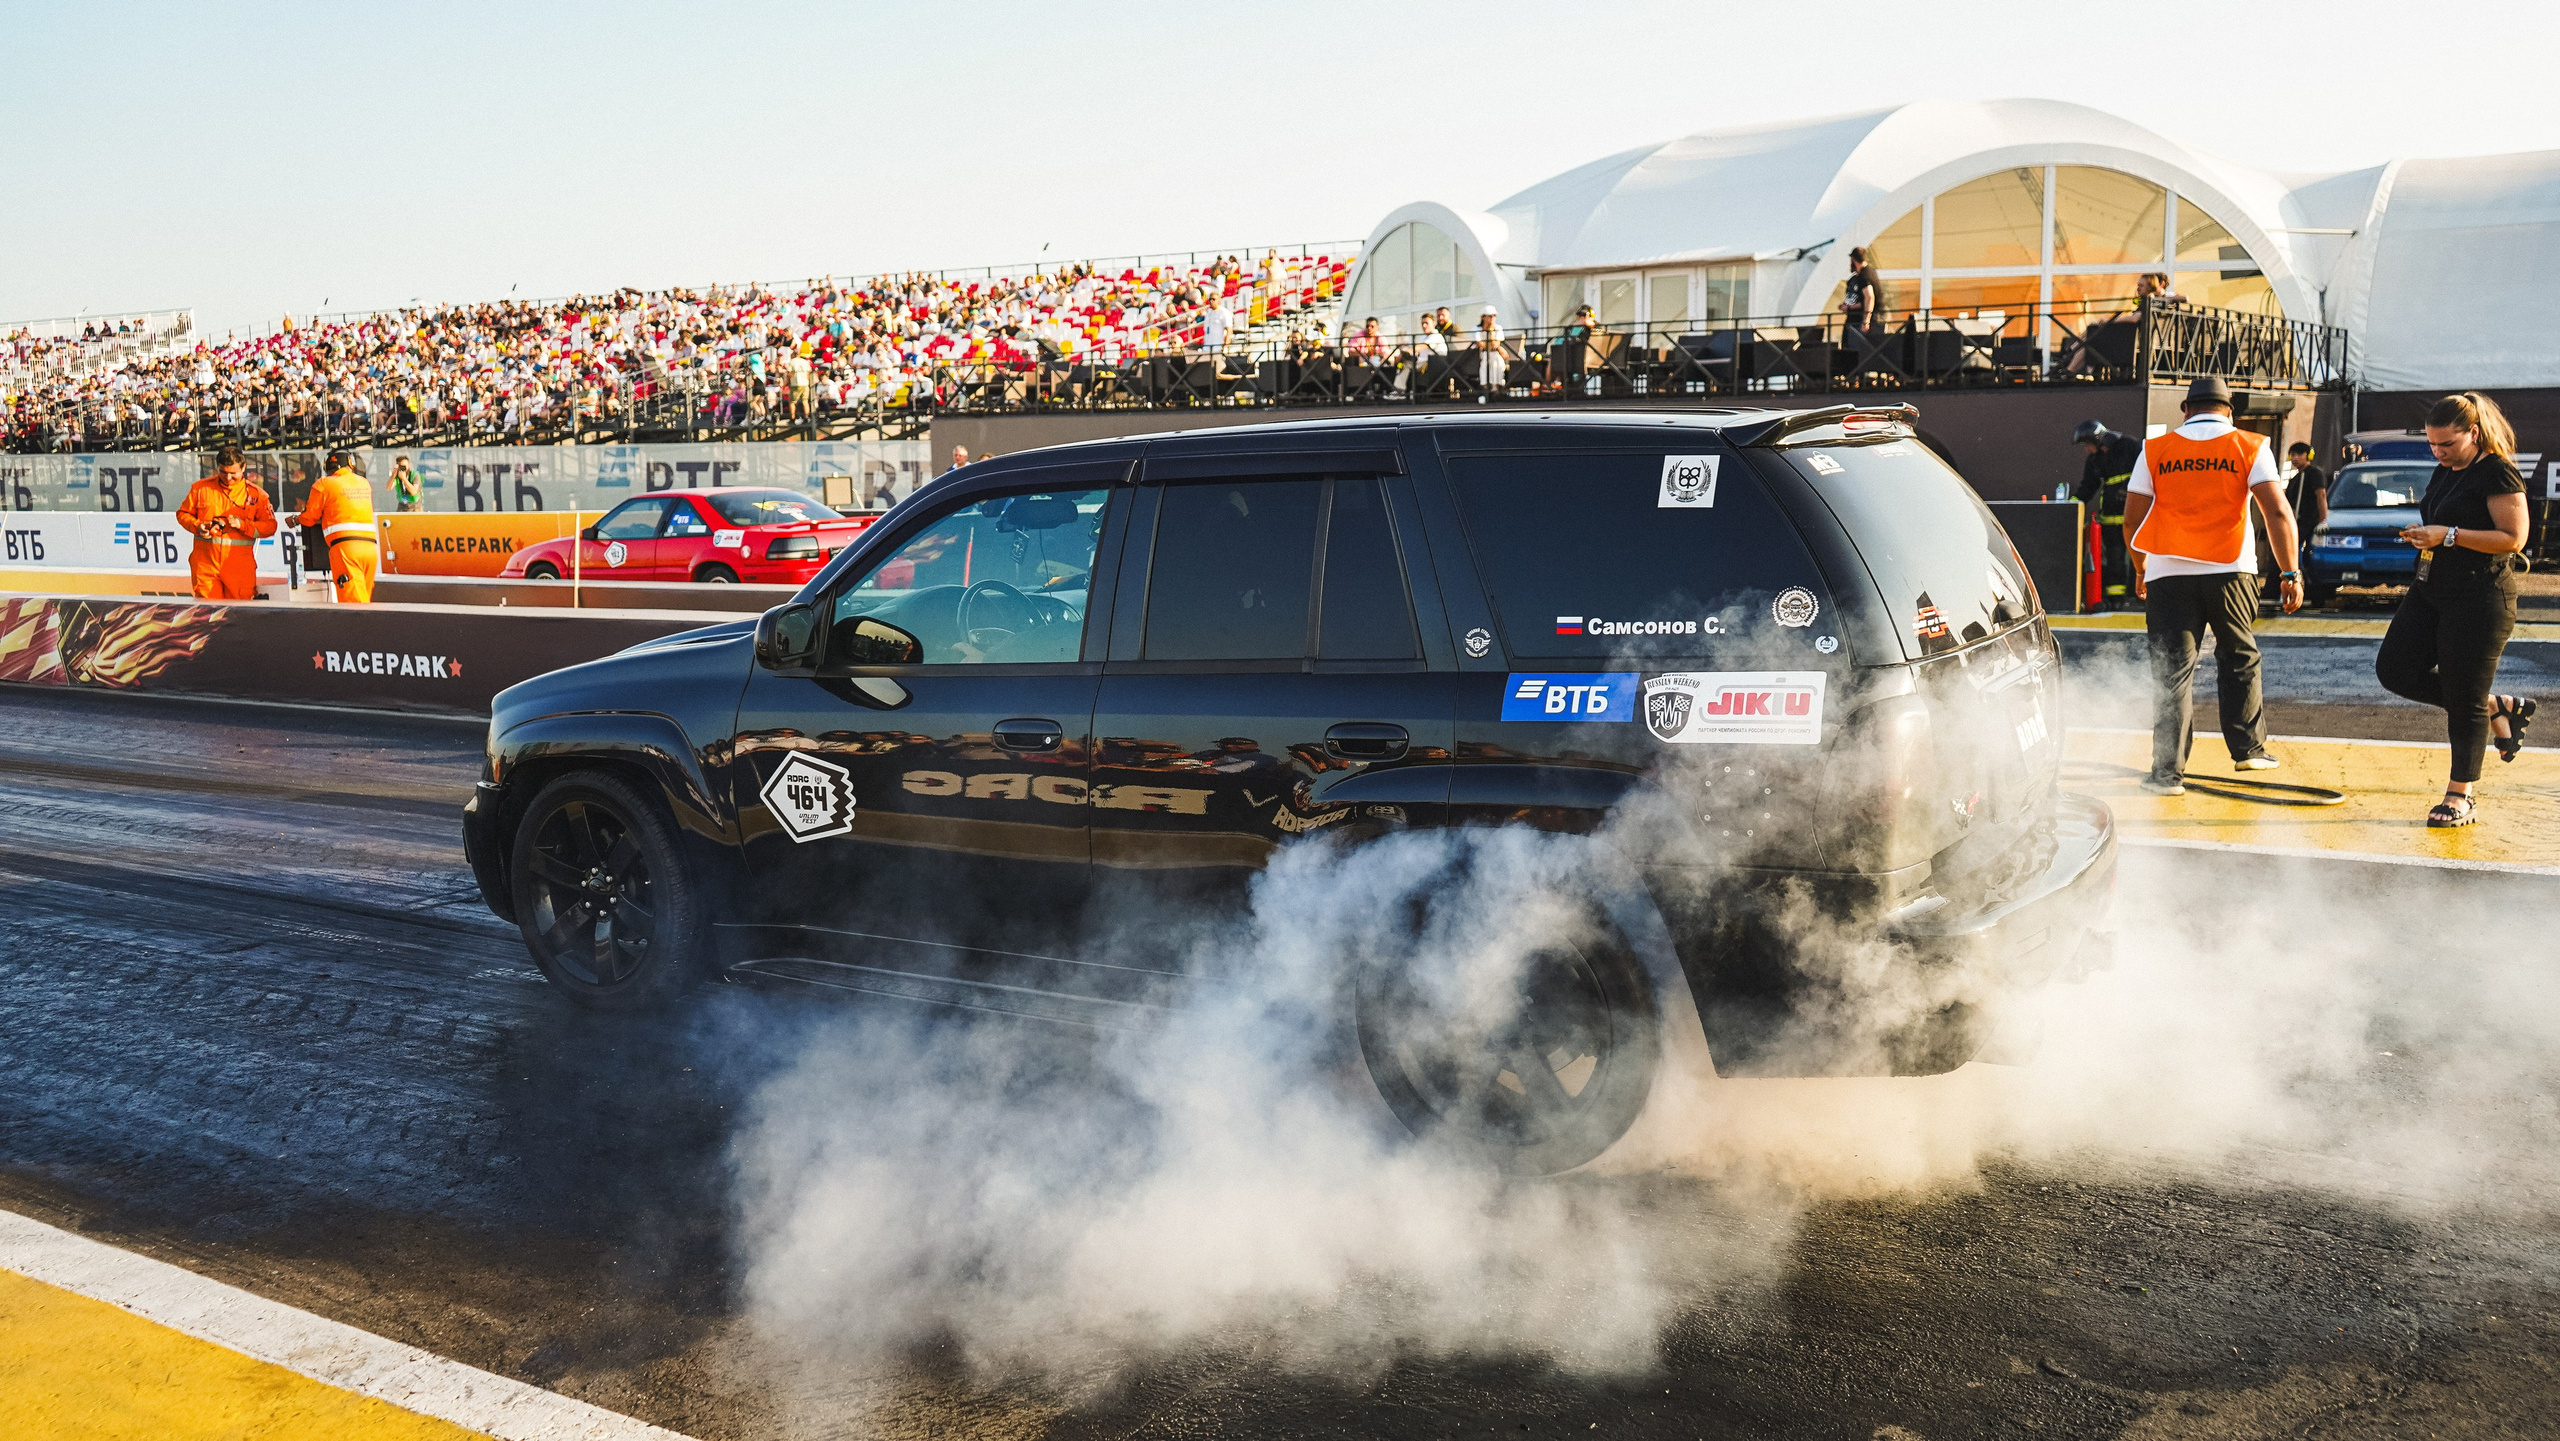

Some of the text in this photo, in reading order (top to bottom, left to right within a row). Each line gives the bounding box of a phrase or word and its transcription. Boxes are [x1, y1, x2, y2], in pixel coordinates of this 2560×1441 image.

[2159, 458, 2238, 475] MARSHAL
[100, 467, 163, 512] ВТБ
[457, 463, 543, 511] ВТБ
[864, 461, 932, 508] ВТ
[5, 530, 45, 560] ВТБ
[134, 531, 178, 563] ВТБ
[421, 537, 513, 553] RACEPARK
[1588, 616, 1726, 635] Самсонов С.
[325, 651, 448, 678] RACEPARK
[1647, 677, 1701, 689] RUSSIAN WEEKEND
[1545, 685, 1609, 714] ВТБ
[787, 775, 809, 783] RDRC
[787, 784, 828, 811] 464
